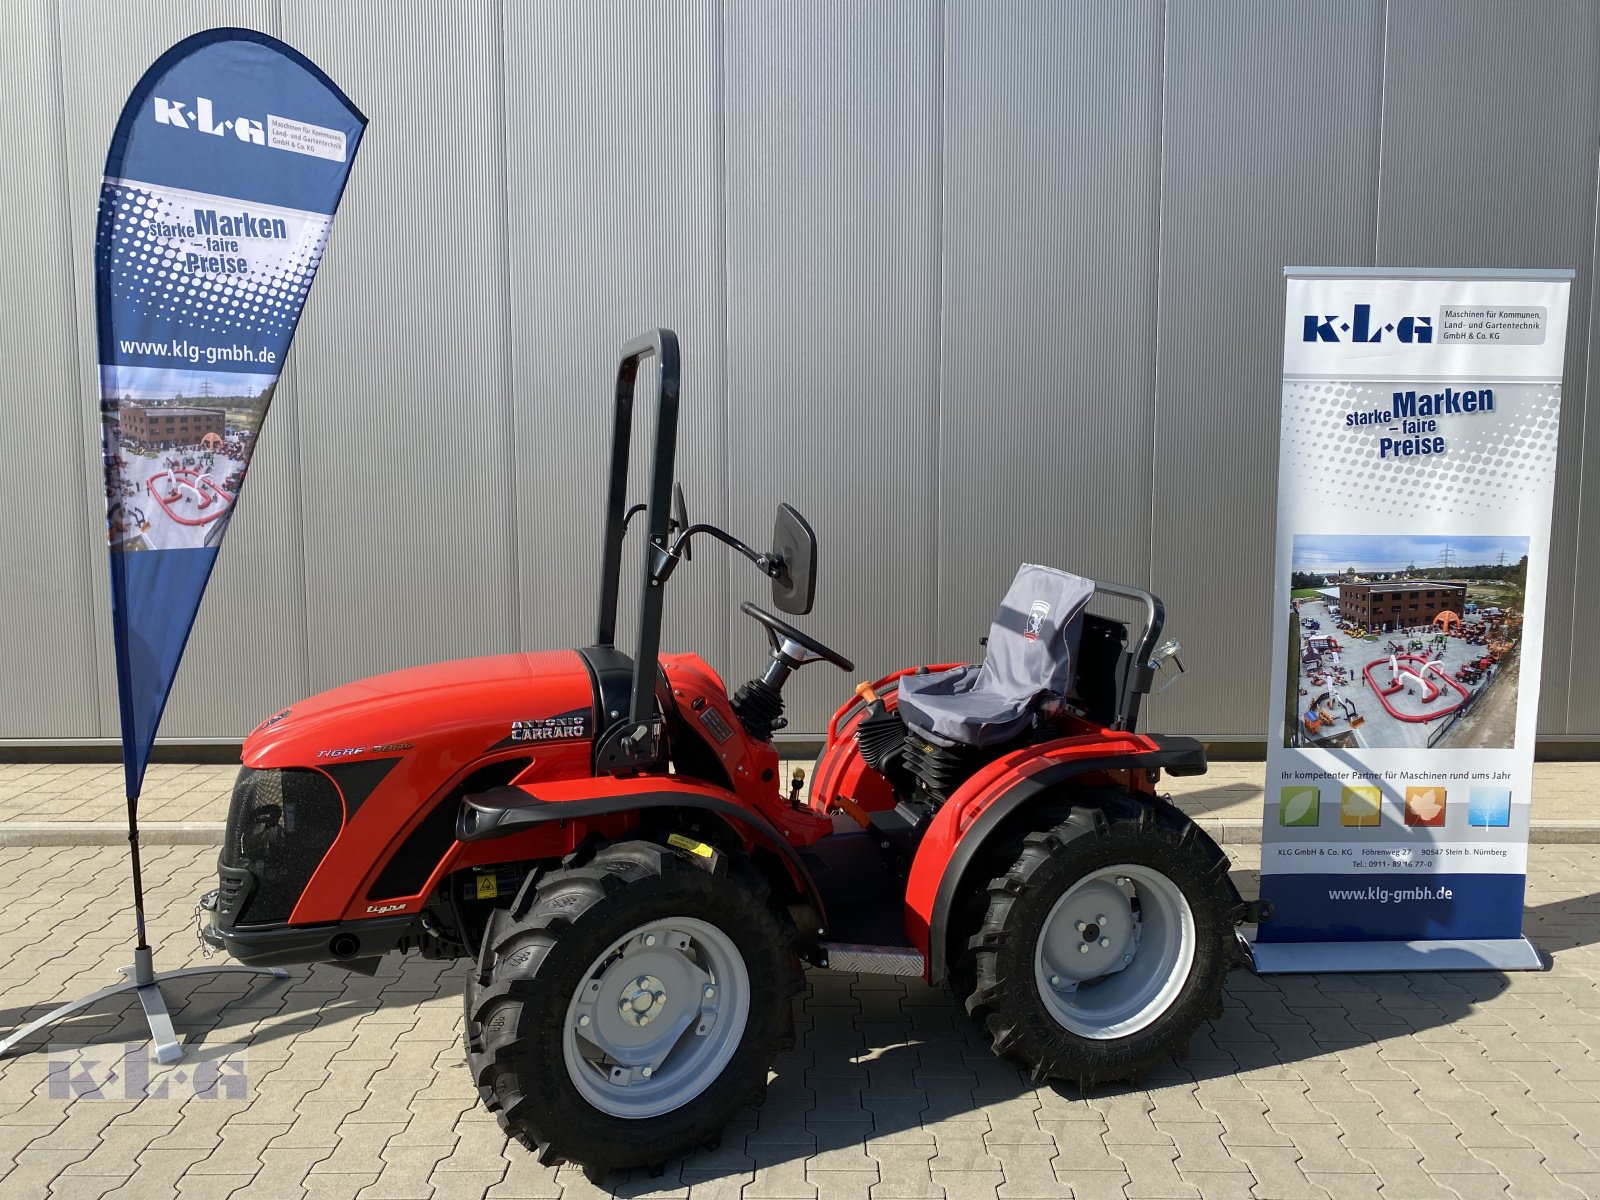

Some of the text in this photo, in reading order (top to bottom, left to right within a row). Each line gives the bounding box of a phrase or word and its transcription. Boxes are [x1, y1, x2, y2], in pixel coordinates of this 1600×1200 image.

[272, 119, 343, 143] Maschinen für Kommunen,
[272, 128, 342, 149] Land- und Gartentechnik
[272, 137, 290, 146] GmbH
[306, 144, 315, 152] KG
[150, 208, 287, 239] starke Marken
[206, 238, 239, 252] faire
[185, 252, 248, 274] Preise
[1445, 310, 1541, 320] Maschinen für Kommunen,
[1444, 321, 1466, 329] Land-
[1468, 321, 1483, 329] und
[1443, 332, 1500, 340] GmbH & Co. KG
[119, 338, 276, 363] www.klg-gmbh.de
[1346, 387, 1494, 427] starke Marken
[1402, 418, 1437, 435] faire
[1379, 436, 1445, 459] Preise
[511, 716, 585, 729] ANTONIO
[511, 725, 585, 740] CARRARO
[316, 746, 367, 758] TIGRE
[1281, 771, 1293, 779] Ihr
[1294, 770, 1349, 781] kompetenter
[1352, 771, 1382, 780] Partner
[1385, 770, 1398, 779] für
[1399, 770, 1447, 780] Maschinen
[1449, 771, 1469, 780] rund
[1492, 771, 1512, 780] Jahr
[1294, 848, 1317, 856] GmbH
[1361, 848, 1400, 857] Föhrenweg
[1445, 848, 1463, 856] Stein
[1464, 848, 1471, 856] b.
[1473, 848, 1508, 857] Nürnberg
[1415, 860, 1433, 868] 77-0
[1328, 886, 1453, 903] www.klg-gmbh.de
